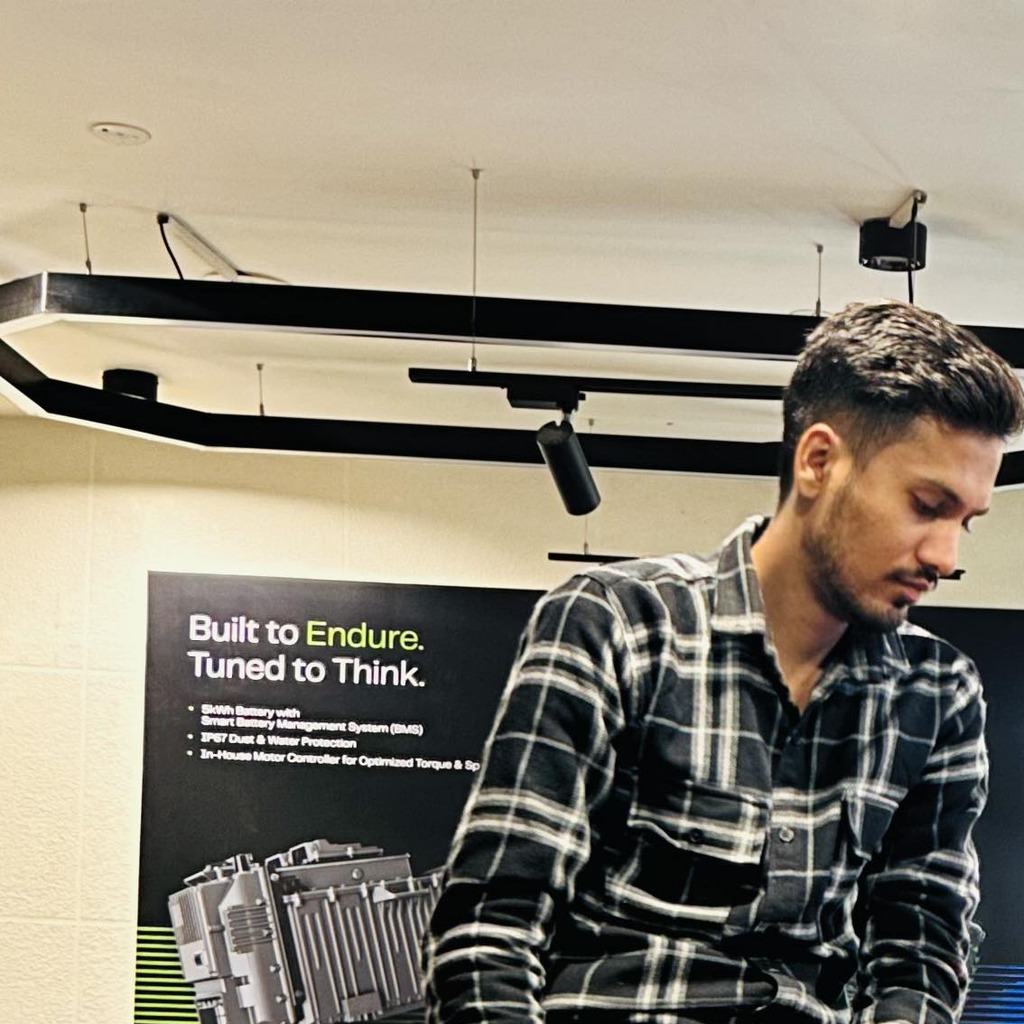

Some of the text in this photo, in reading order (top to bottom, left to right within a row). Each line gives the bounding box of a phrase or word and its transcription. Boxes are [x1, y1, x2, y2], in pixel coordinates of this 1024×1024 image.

[189, 614, 425, 651] Built to Endure.
[187, 651, 426, 688] Tuned to Think.
[235, 705, 275, 719] Battery
[275, 707, 300, 718] with
[201, 715, 235, 726] Smart
[236, 716, 275, 730] Battery
[276, 719, 347, 732] Management
[347, 721, 389, 734] System
[228, 734, 255, 744] Dust
[256, 734, 266, 745] &
[267, 735, 300, 746] Water
[301, 736, 357, 748] Protection
[200, 749, 252, 761] In-House
[253, 751, 286, 762] Motor
[286, 752, 341, 764] Controller
[341, 754, 357, 765] for
[359, 755, 414, 767] Optimized
[415, 758, 452, 771] Torque
[453, 759, 463, 770] &
